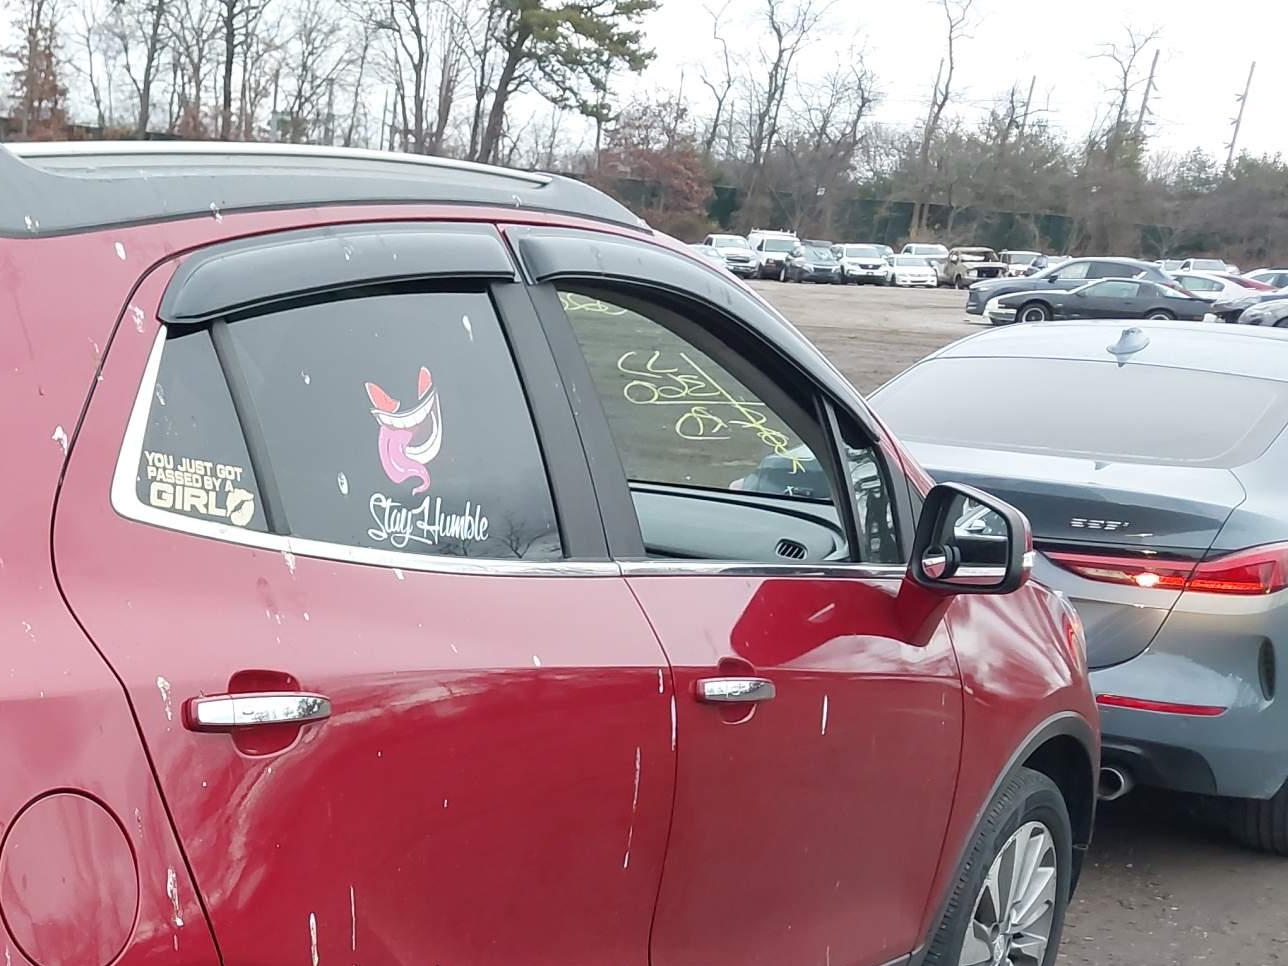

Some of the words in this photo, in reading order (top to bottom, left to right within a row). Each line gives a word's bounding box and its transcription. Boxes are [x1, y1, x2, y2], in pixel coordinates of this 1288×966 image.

[144, 451, 174, 468] YOU
[177, 457, 213, 476] JUST
[216, 465, 243, 482] GOT
[147, 466, 202, 488] PASSED
[204, 475, 222, 491] BY
[224, 481, 234, 492] A
[150, 481, 227, 517] GIRL
[368, 493, 430, 547] Stay
[412, 496, 489, 544] Humble
